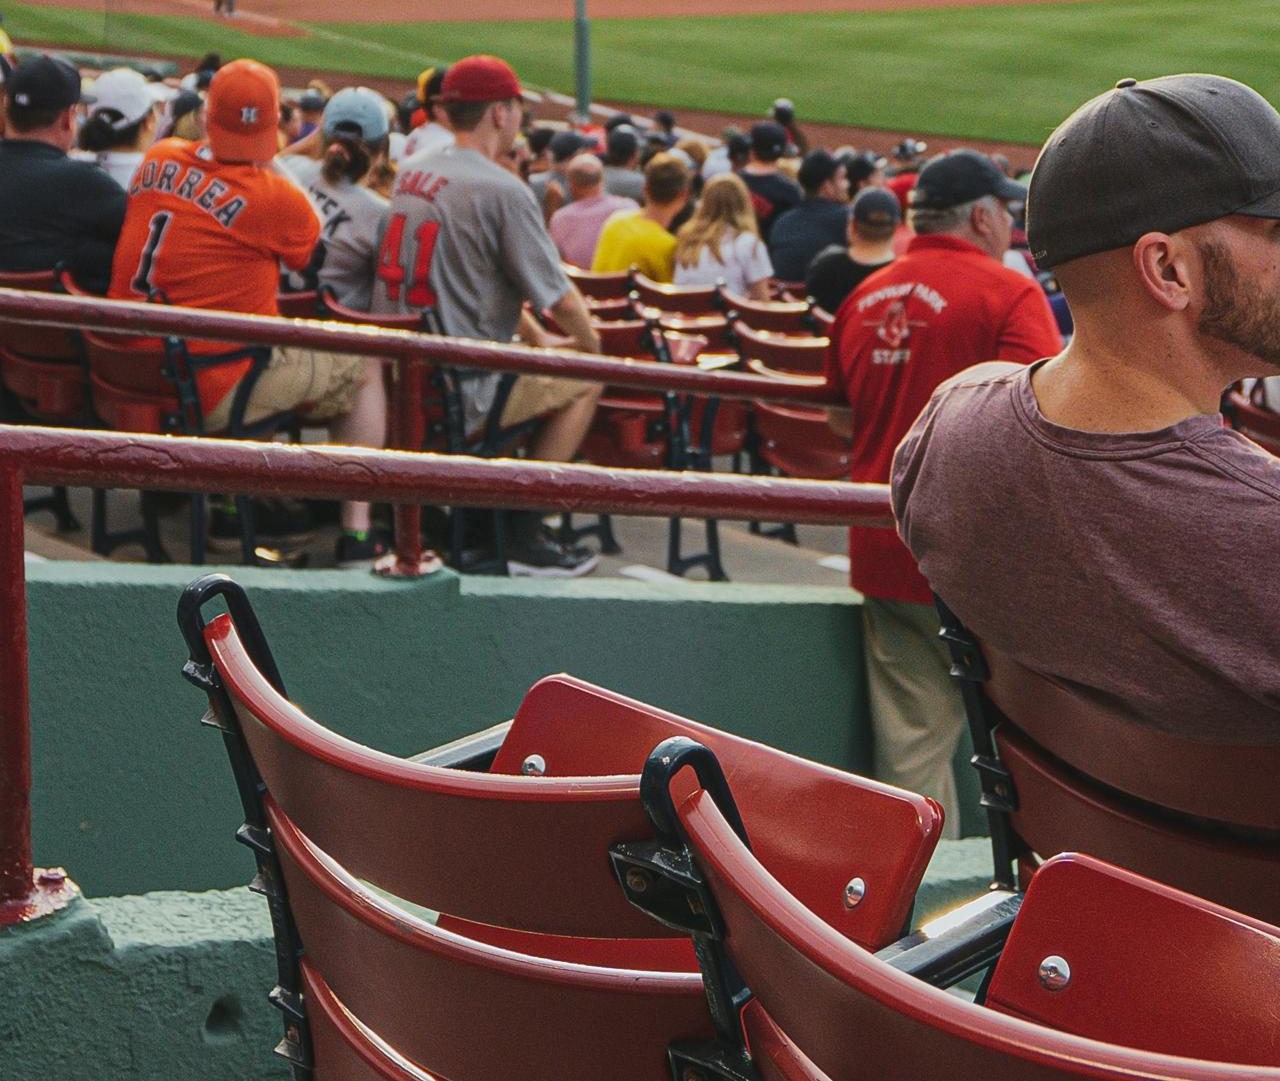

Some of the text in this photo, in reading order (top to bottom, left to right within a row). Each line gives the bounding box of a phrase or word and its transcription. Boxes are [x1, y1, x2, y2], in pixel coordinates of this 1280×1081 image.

[395, 170, 449, 202] SALE
[130, 210, 174, 295] 1
[377, 214, 440, 307] 41
